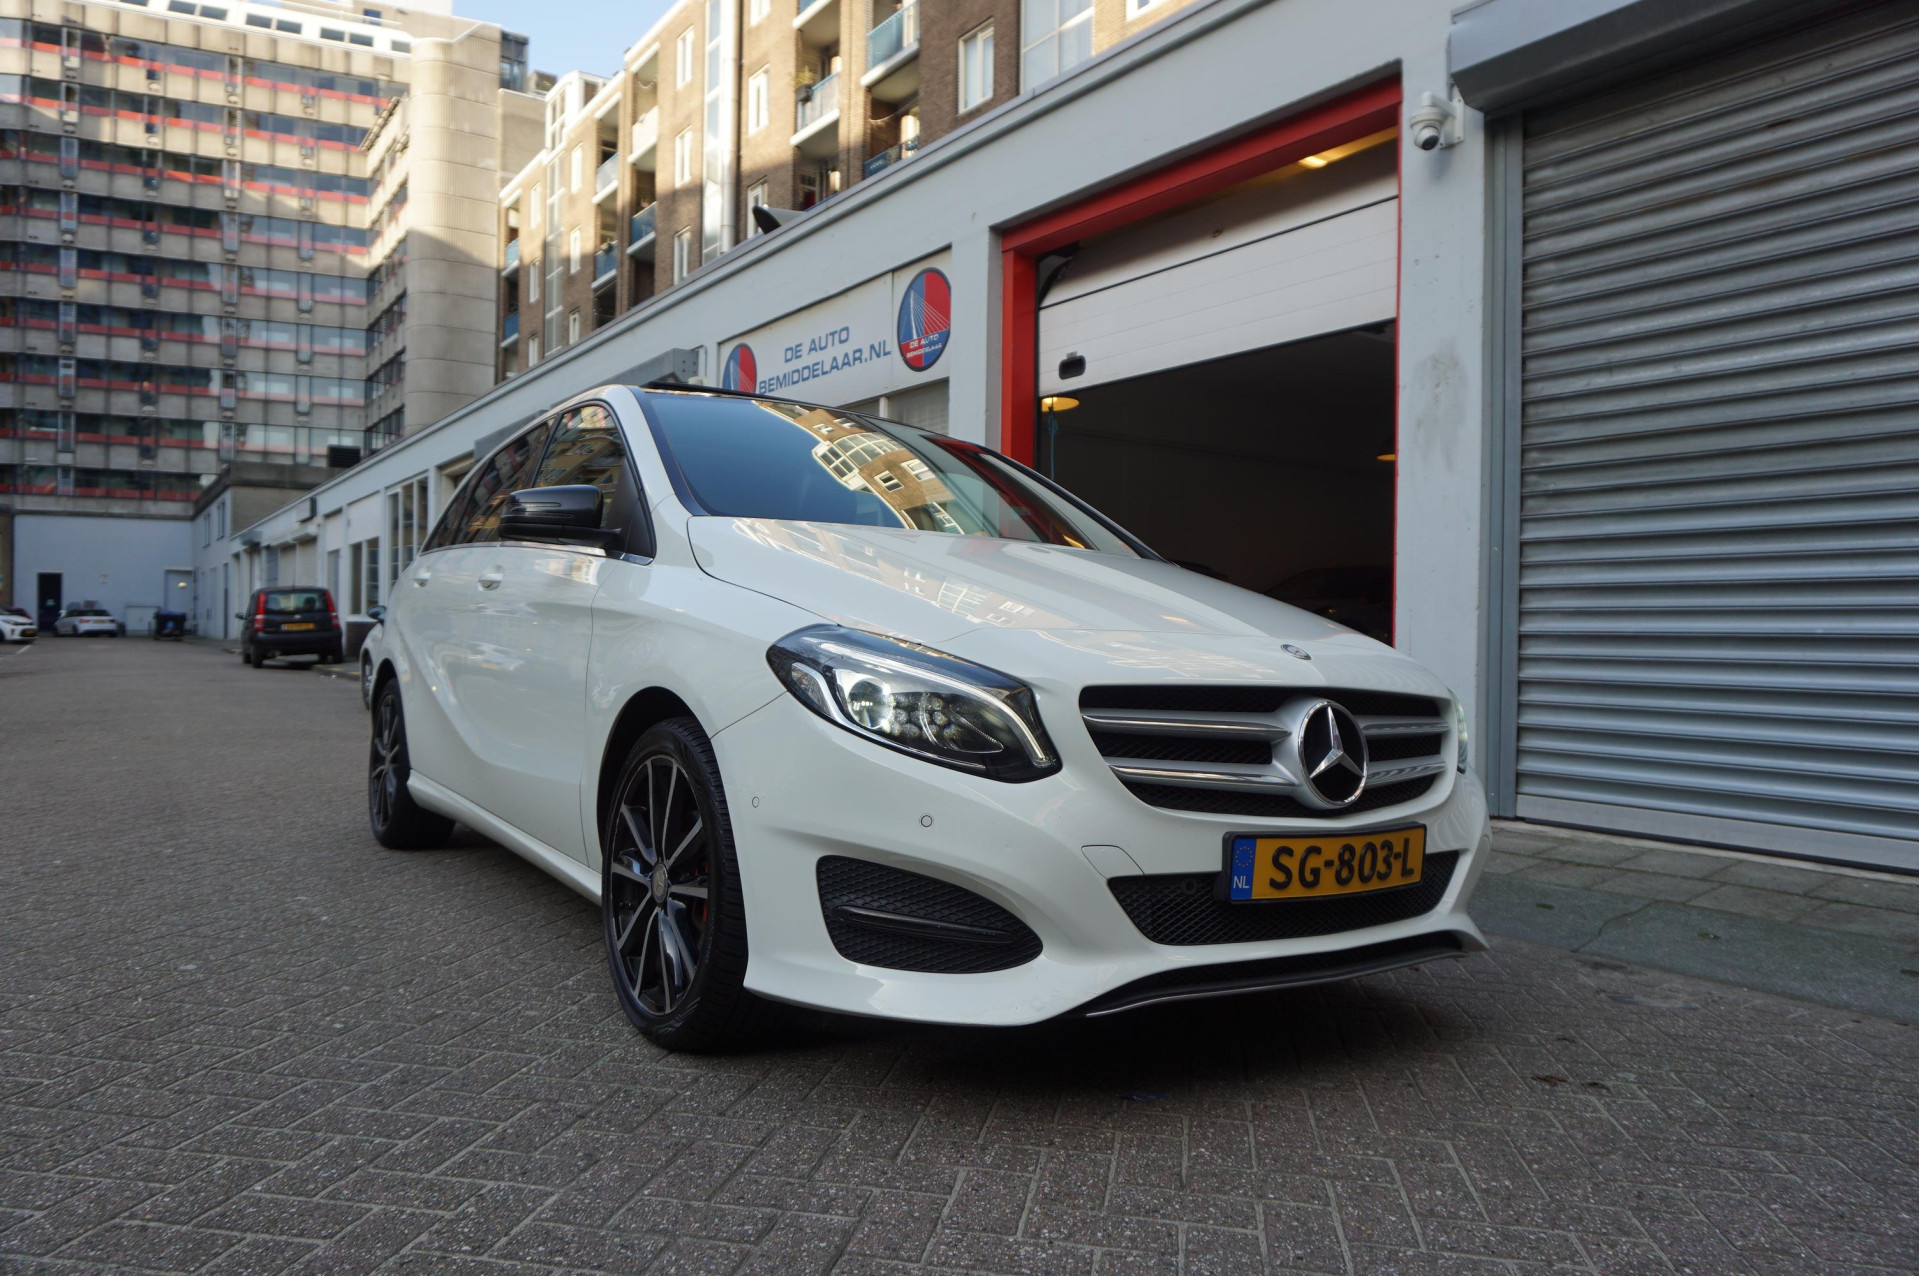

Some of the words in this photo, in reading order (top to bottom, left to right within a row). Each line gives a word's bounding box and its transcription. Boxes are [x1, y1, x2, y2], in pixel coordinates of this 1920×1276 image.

[784, 343, 803, 363] DE
[808, 326, 850, 355] AUTO
[909, 340, 919, 349] DE
[920, 333, 939, 345] AUTO
[759, 340, 892, 395] BEMIDDELAAR.NL
[1233, 875, 1250, 889] NL
[1269, 837, 1415, 890] SG-803-L
